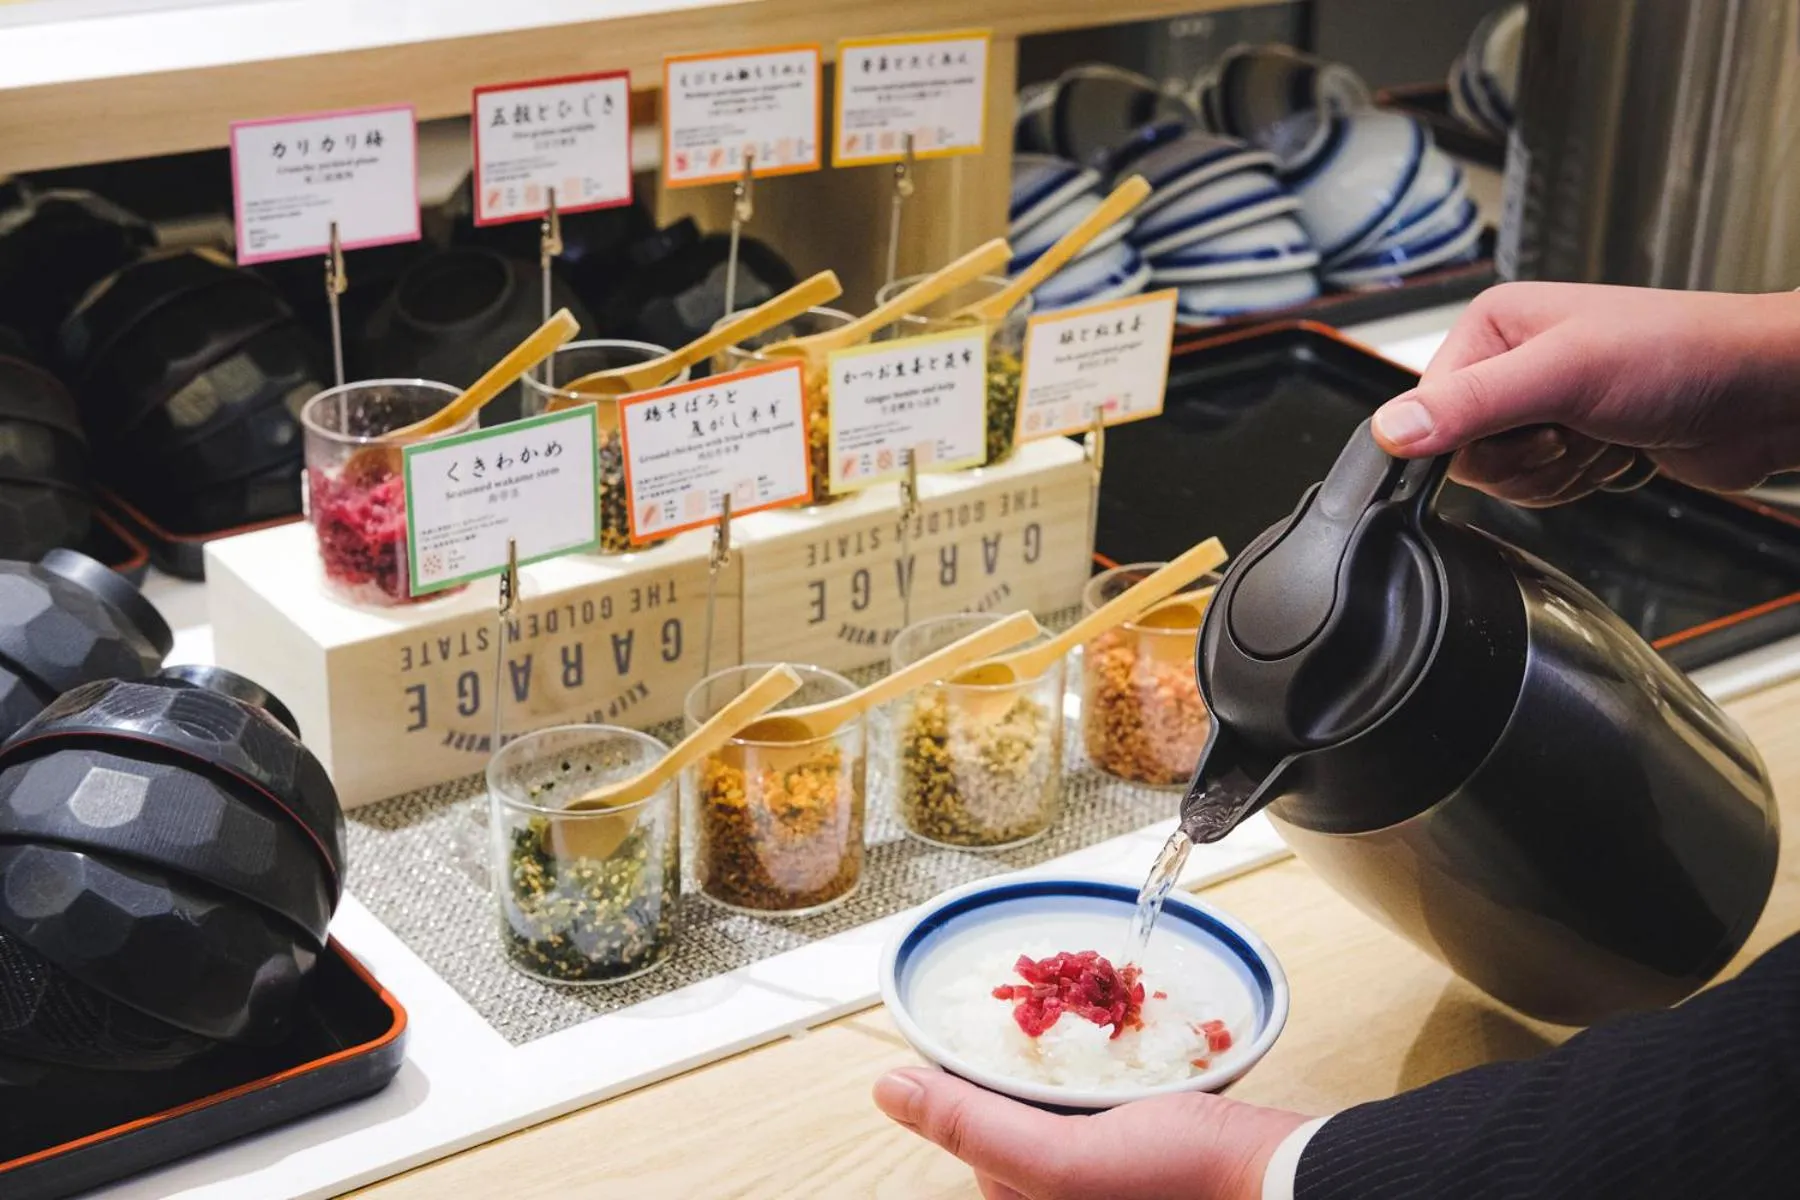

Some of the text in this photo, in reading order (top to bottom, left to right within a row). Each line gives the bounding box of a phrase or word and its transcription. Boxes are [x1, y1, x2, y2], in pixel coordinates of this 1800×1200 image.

[272, 130, 383, 159] カリカリ梅
[446, 441, 563, 482] くきわかめ
[446, 481, 493, 500] Seasoned
[494, 473, 534, 489] wakame
[536, 466, 560, 480] stem
[1001, 488, 1041, 516] THE
[807, 527, 881, 567] STATE
[809, 523, 1041, 624] GARAGE
[400, 580, 678, 671] THE GOLDEN STATE
[405, 618, 682, 733] GARAGE
